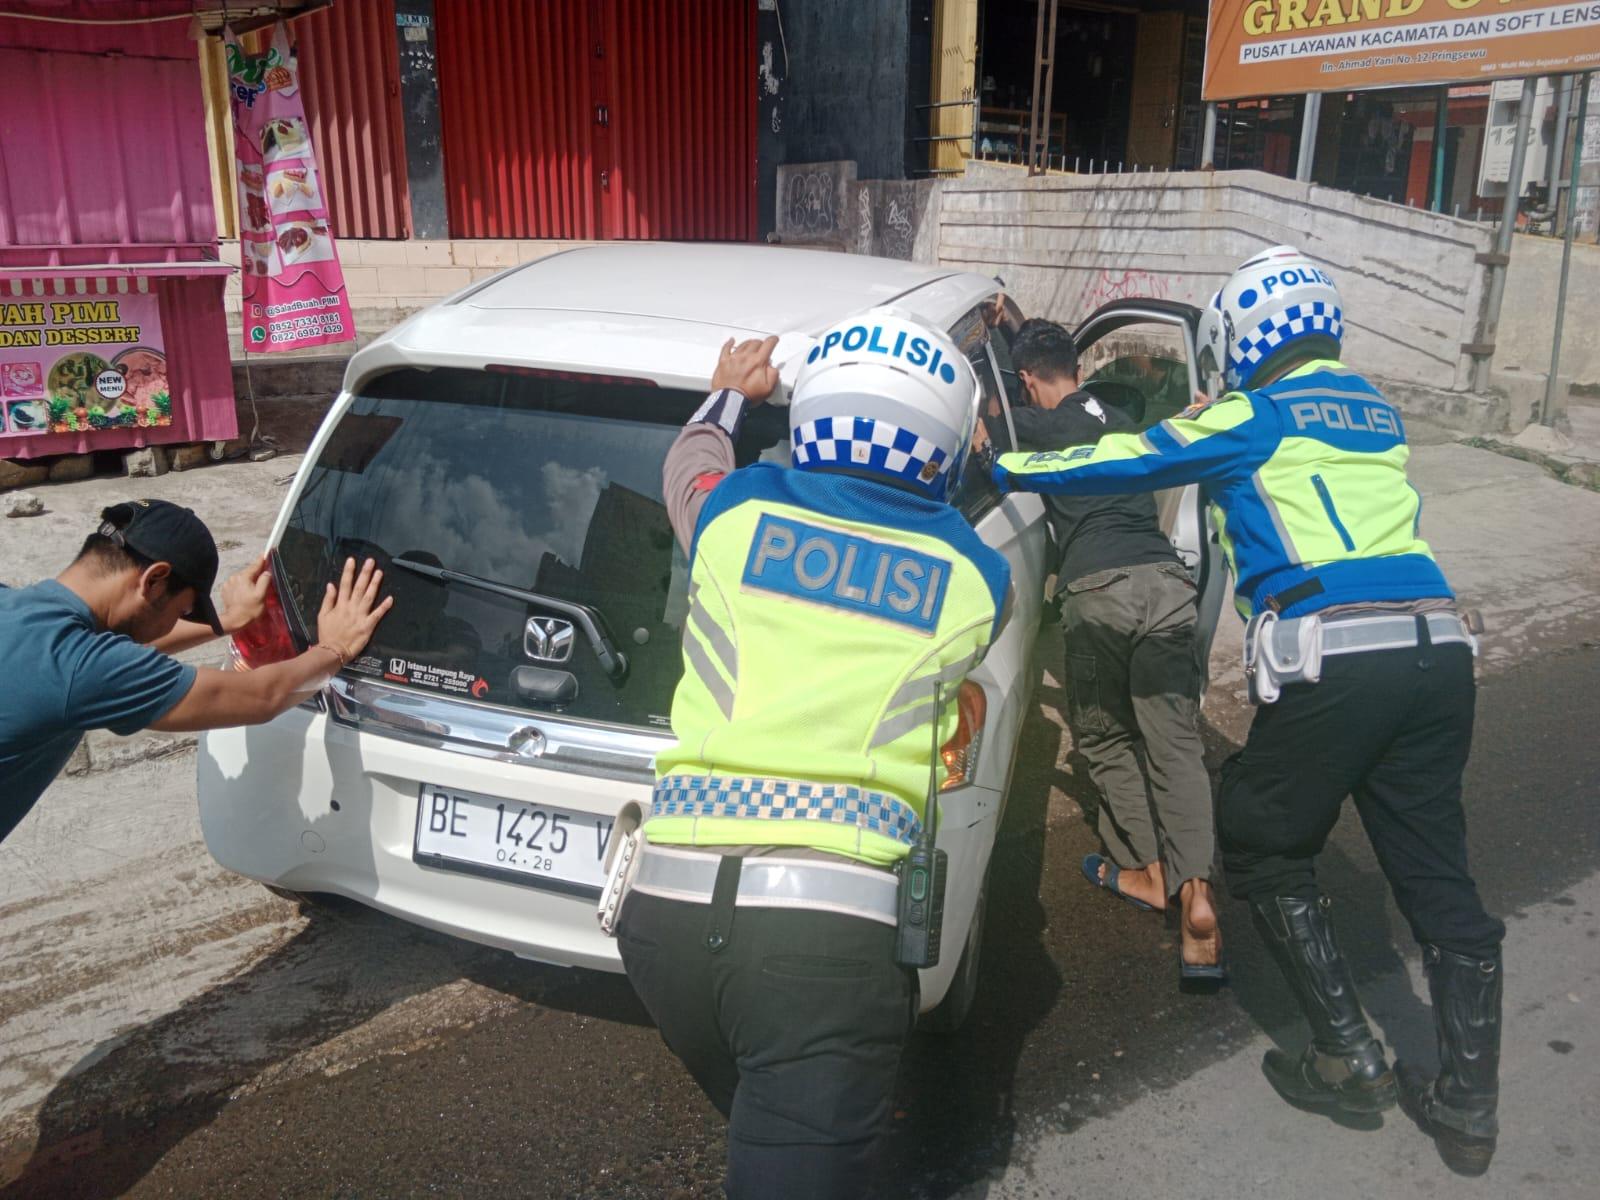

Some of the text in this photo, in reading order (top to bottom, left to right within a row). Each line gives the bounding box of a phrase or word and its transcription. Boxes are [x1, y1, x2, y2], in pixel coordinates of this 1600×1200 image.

[1243, 43, 1287, 60] PUSAT
[1290, 34, 1357, 55] LAYANAN
[1360, 24, 1448, 45] KACAMATA
[1453, 19, 1490, 37] DAN
[1495, 12, 1544, 32] SOFT
[1338, 57, 1372, 70] Ahmad
[1374, 55, 1394, 66] Yani
[1417, 53, 1429, 63] 12
[1431, 48, 1487, 62] Pringsewu
[1261, 267, 1337, 295] POLISI
[50, 301, 120, 325] PIMI
[269, 321, 292, 333] 0852
[295, 316, 319, 328] 7334
[0, 326, 140, 347] DAN DESSERT
[271, 324, 342, 343] 0822 6982 4329
[820, 325, 943, 376] POLISI
[98, 376, 122, 385] NEW
[99, 383, 123, 392] MENU
[1289, 401, 1401, 437] POLISI
[751, 523, 943, 622] POLISI
[429, 792, 470, 838] BE
[495, 803, 571, 853] 1425
